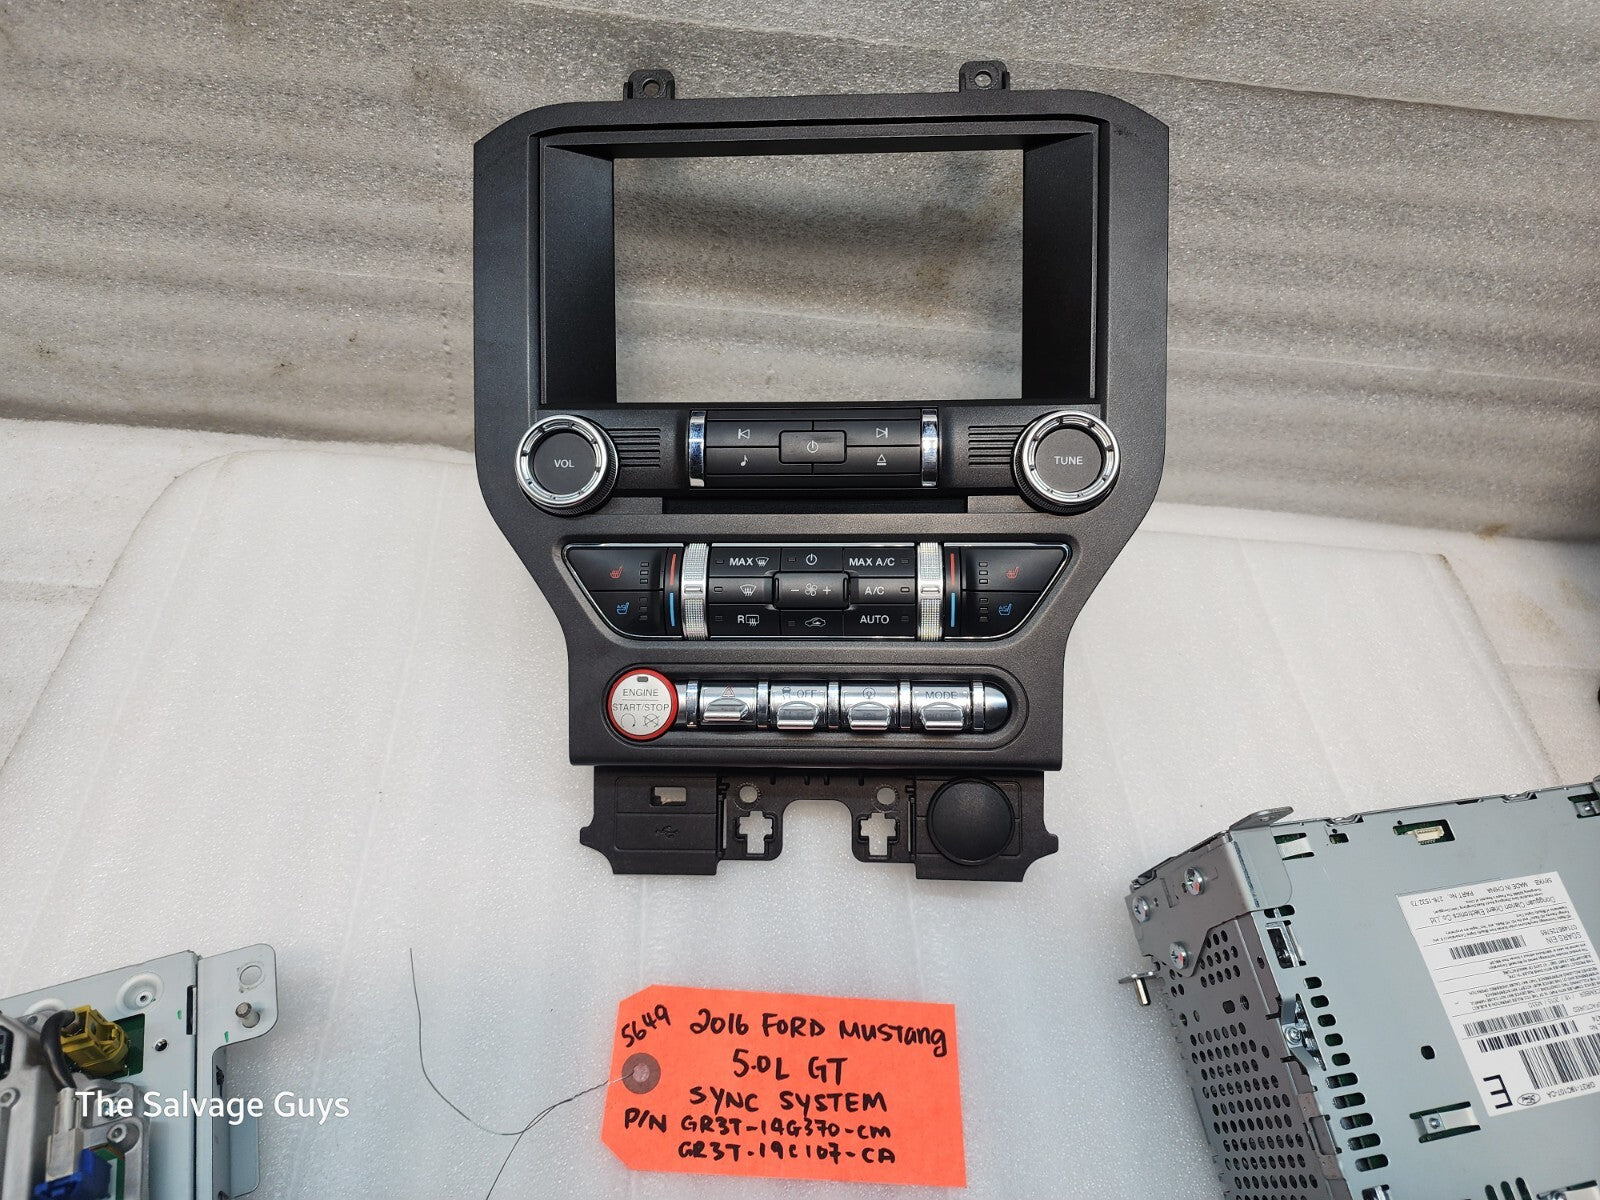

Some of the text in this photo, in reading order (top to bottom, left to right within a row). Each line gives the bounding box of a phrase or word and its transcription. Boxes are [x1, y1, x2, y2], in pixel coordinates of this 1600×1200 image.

[554, 459, 574, 468] VOL
[1054, 456, 1083, 465] TUNE
[730, 557, 753, 566] MAX
[849, 557, 895, 567] MAX A/C
[865, 585, 884, 595] A/C
[738, 615, 744, 624] R
[860, 615, 889, 624] AUTO
[623, 688, 658, 697] ENGINE
[797, 690, 817, 698] OFF
[926, 691, 958, 700] MODE
[612, 703, 669, 711] START/STOP
[1485, 885, 1504, 893] CHINA
[1511, 881, 1528, 889] MADE
[1456, 890, 1474, 898] PART
[1524, 894, 1555, 906] Dongguan
[1503, 900, 1525, 910] Clarion
[1451, 908, 1485, 920] Electronics
[621, 1004, 672, 1047] 5649
[690, 1009, 749, 1036] 2016
[762, 1013, 825, 1037] FORD
[733, 1049, 848, 1085] 5.0L GT
[1482, 1074, 1512, 1109] E
[689, 1086, 887, 1117] SYNC SYSTEM
[625, 1107, 666, 1132] P/N
